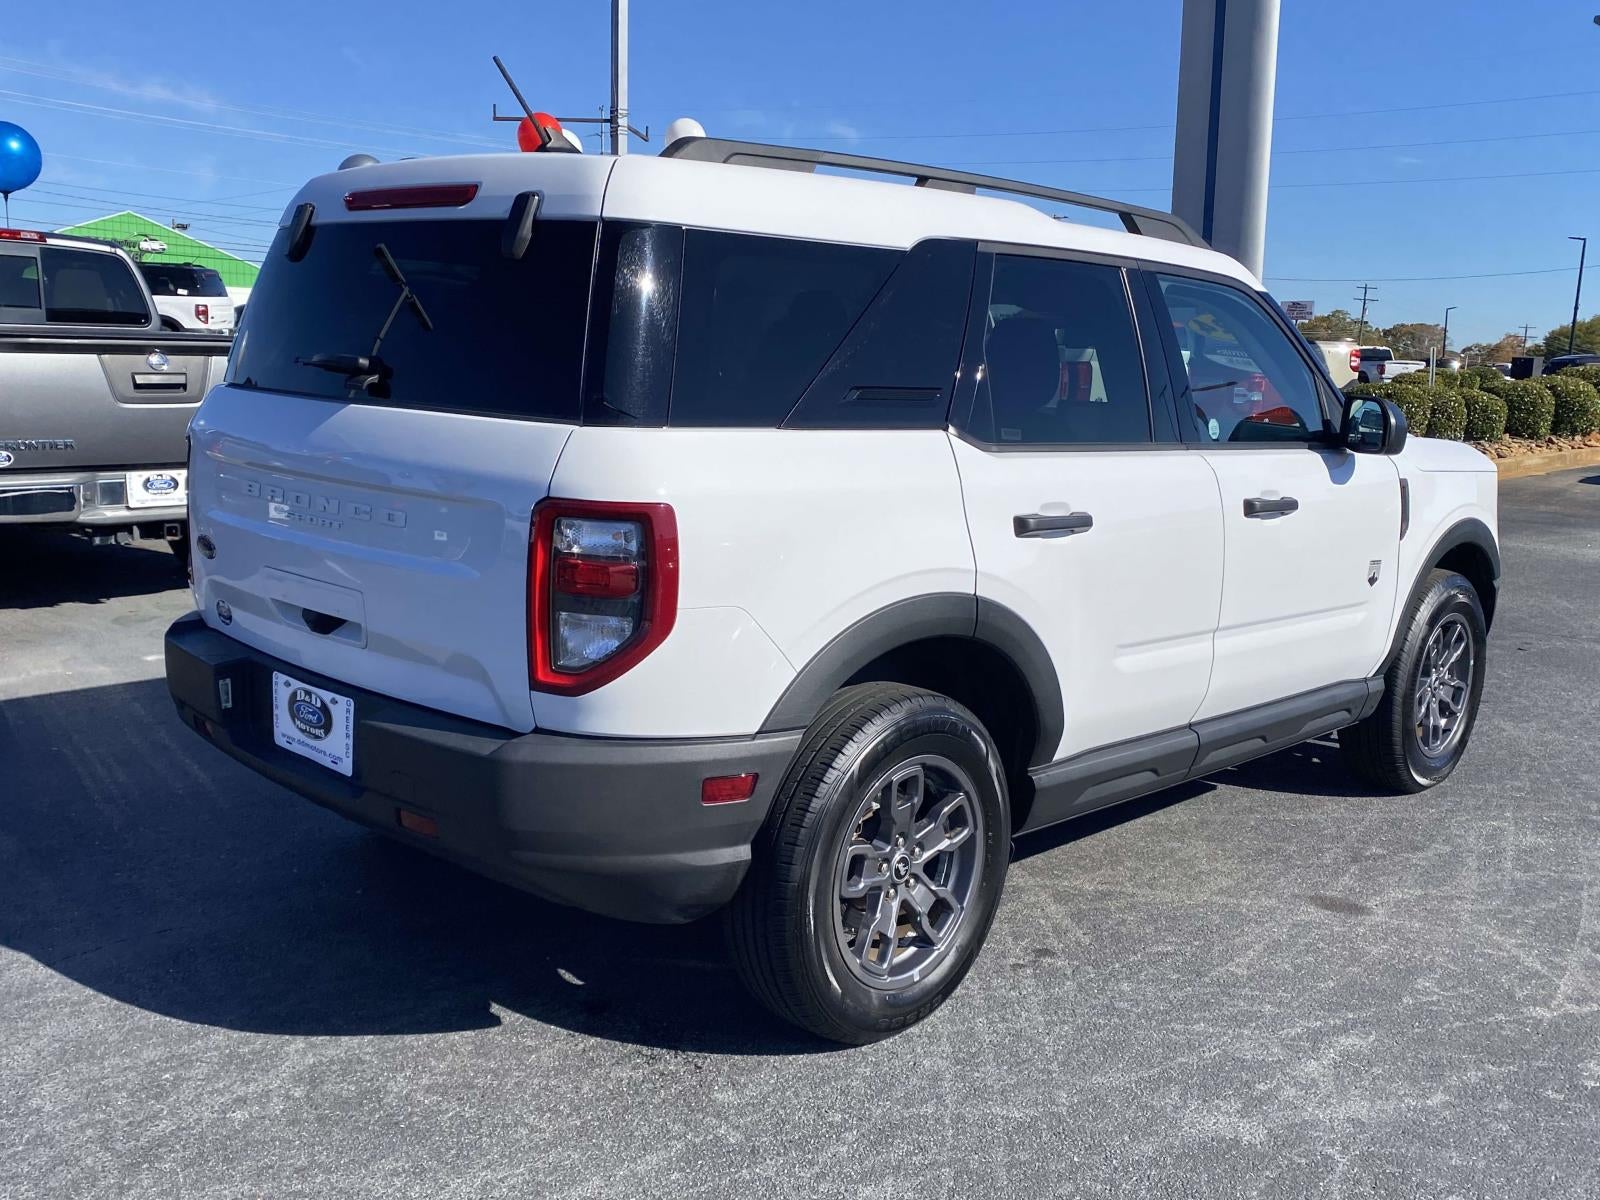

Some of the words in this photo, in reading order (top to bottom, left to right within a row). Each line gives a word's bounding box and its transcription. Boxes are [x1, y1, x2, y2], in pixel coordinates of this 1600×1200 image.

[247, 481, 407, 528] BRONCO
[295, 688, 322, 708] D&D
[300, 704, 319, 723] Ford
[294, 717, 325, 738] MOTORS
